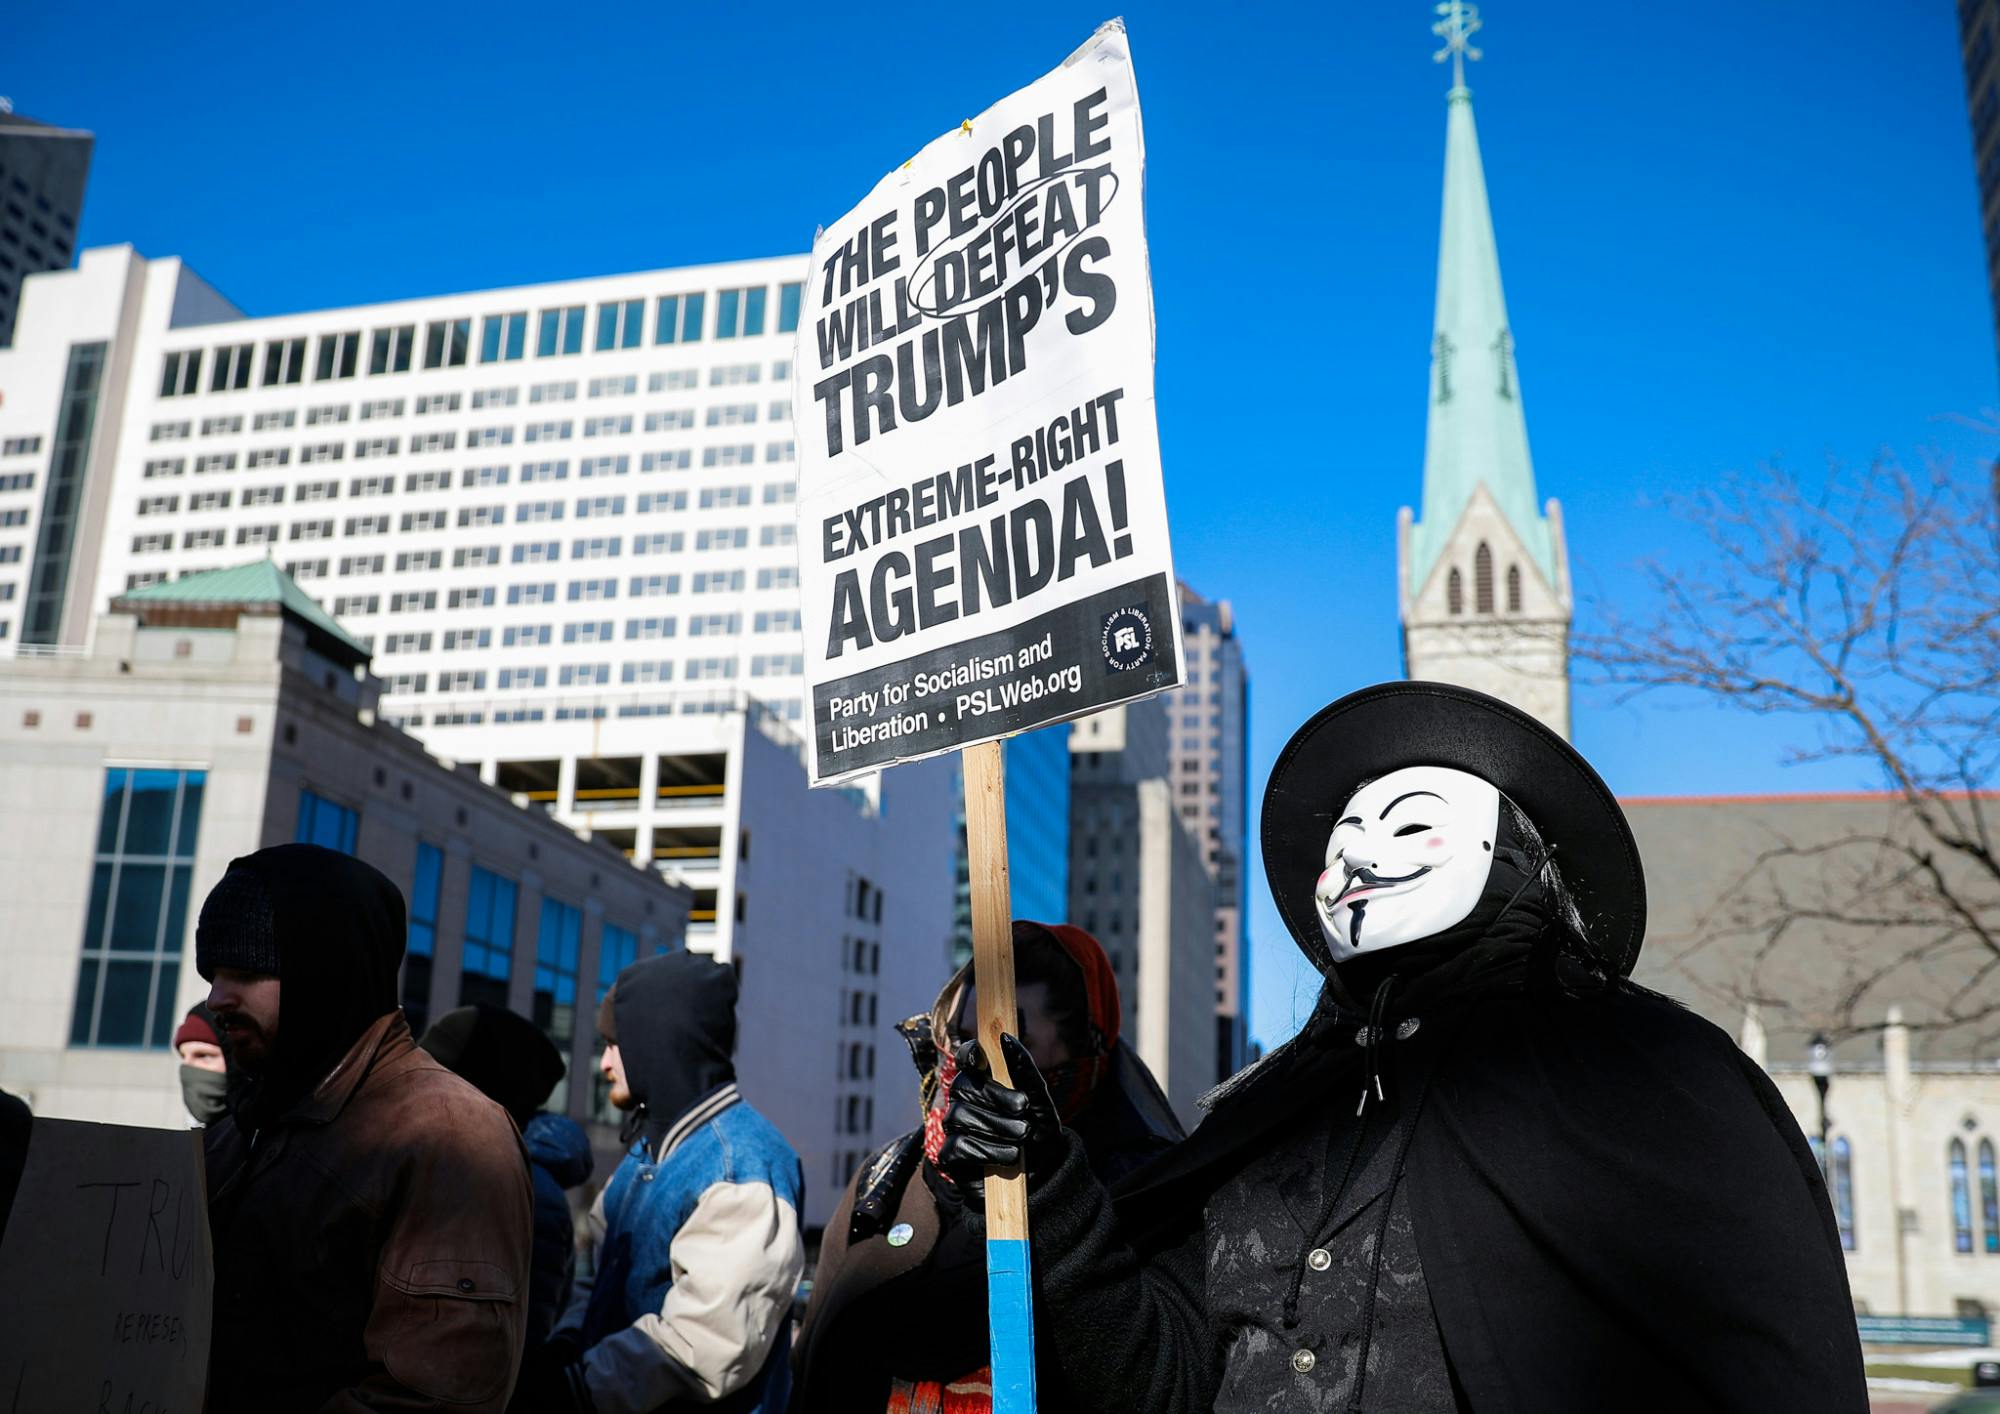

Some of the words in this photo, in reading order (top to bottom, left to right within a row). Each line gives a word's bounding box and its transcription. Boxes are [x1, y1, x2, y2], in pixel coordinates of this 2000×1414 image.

[822, 209, 900, 308] THE
[914, 86, 1111, 258] PEOPLE
[816, 275, 922, 370] WILL
[933, 163, 1112, 316] DEFEAT
[813, 236, 1117, 458] TRUMP'S
[823, 388, 1124, 563] EXTREME-RIGHT
[825, 458, 1134, 660] AGENDA!
[1101, 611, 1119, 658] SOCIALISM
[1109, 657, 1124, 670] FOR
[1114, 627, 1140, 653] PSL
[1126, 651, 1148, 671] PARTY
[1127, 607, 1152, 650] LIBERATION
[829, 690, 879, 721] Party
[882, 683, 910, 705] for
[914, 652, 1014, 698] Socialism
[1018, 633, 1053, 669] and
[831, 711, 928, 753] Liberation
[956, 664, 1083, 720] PSLWeb.org
